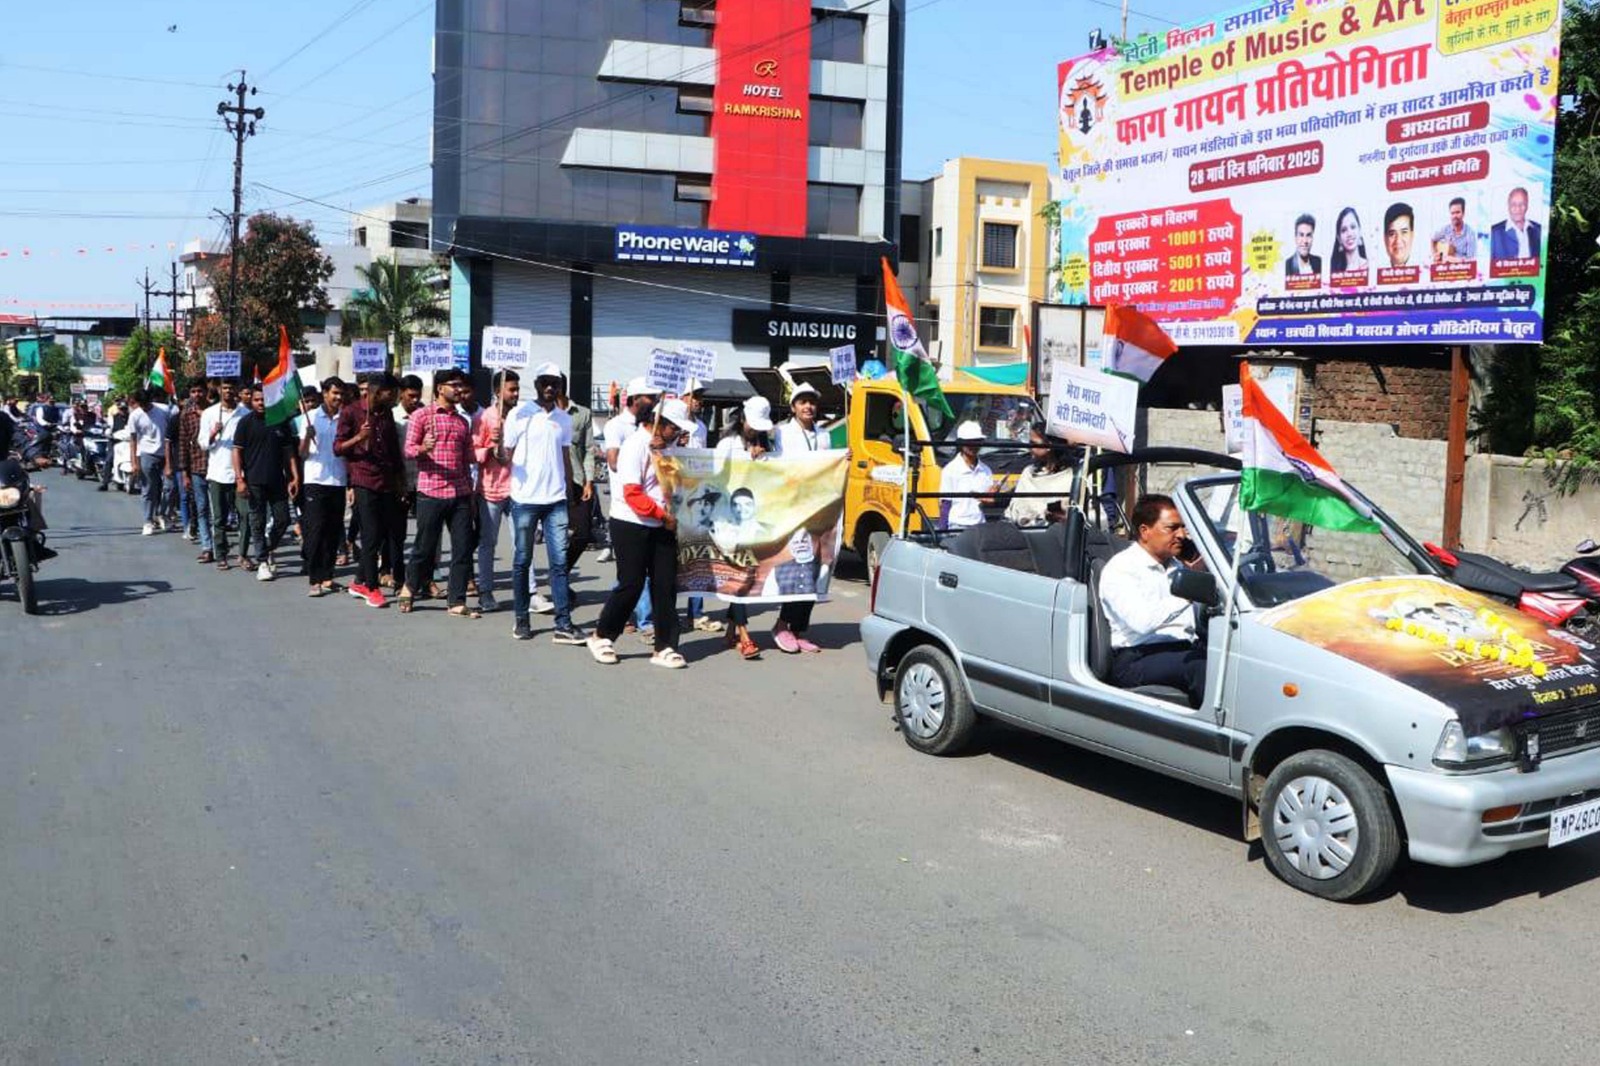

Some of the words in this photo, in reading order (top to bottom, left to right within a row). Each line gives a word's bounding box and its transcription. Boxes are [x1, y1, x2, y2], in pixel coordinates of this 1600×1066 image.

[1120, 54, 1203, 94] Temple
[1211, 40, 1235, 70] of
[1245, 19, 1327, 62] Music
[1339, 5, 1361, 36] &
[1373, 0, 1425, 28] Art
[1166, 22, 1215, 50] मिलन
[743, 84, 783, 98] HOTEL
[1116, 107, 1167, 145] फाग
[1174, 83, 1248, 133] गायन
[1255, 43, 1432, 116] प्रतियोगिता
[724, 103, 802, 120] RAMKRISHNA
[1083, 161, 1100, 177] जिले
[1102, 158, 1113, 172] की
[1172, 143, 1197, 159] गायन
[1200, 131, 1239, 155] मंडलियों
[1256, 127, 1273, 144] इस
[1275, 123, 1297, 139] भव्य
[1300, 107, 1361, 134] प्रतियोगिता
[1365, 101, 1378, 120] में
[1379, 102, 1398, 119] हम
[1402, 94, 1435, 115] सादर
[1439, 80, 1496, 107] आमंत्रित
[1500, 70, 1534, 94] करते
[1400, 111, 1471, 138] अध्यक्षता
[1388, 146, 1398, 160] श्री
[1450, 137, 1461, 150] जी
[1490, 130, 1508, 144] राज्य
[1512, 124, 1528, 141] मंत्री
[1191, 169, 1203, 186] 28
[1208, 162, 1225, 183] मार्च
[1227, 161, 1246, 181] दिन
[1248, 153, 1286, 176] शनिवार
[1287, 149, 1319, 168] 2026
[1390, 164, 1440, 184] आयोजन
[1443, 157, 1481, 175] समिति
[1150, 214, 1163, 228] का
[1165, 209, 1198, 226] विवरण
[618, 231, 730, 253] PhoneWale
[1094, 241, 1115, 255] प्रथम
[1117, 236, 1151, 257] पुरस्कार
[1123, 258, 1159, 279] पुरस्कार
[1169, 254, 1201, 270] 5001
[1094, 281, 1119, 301] तृतीय
[1122, 280, 1158, 300] पुरस्कार
[1169, 277, 1202, 293] 2001
[768, 320, 857, 340] SAMSUNG
[1255, 328, 1277, 339] स्थान
[1285, 324, 1316, 338] छत्रपति
[1318, 323, 1354, 337] शिवाजी
[1356, 325, 1394, 337] महाराज
[1396, 321, 1429, 337] ओपन
[1431, 319, 1501, 336] ऑडिटोरियम
[1066, 379, 1080, 399] मेरा
[1082, 388, 1101, 406] भारत
[1056, 400, 1070, 420] मेरी
[1071, 405, 1106, 430] जिम्मेदारी
[1484, 677, 1517, 691] मेरा
